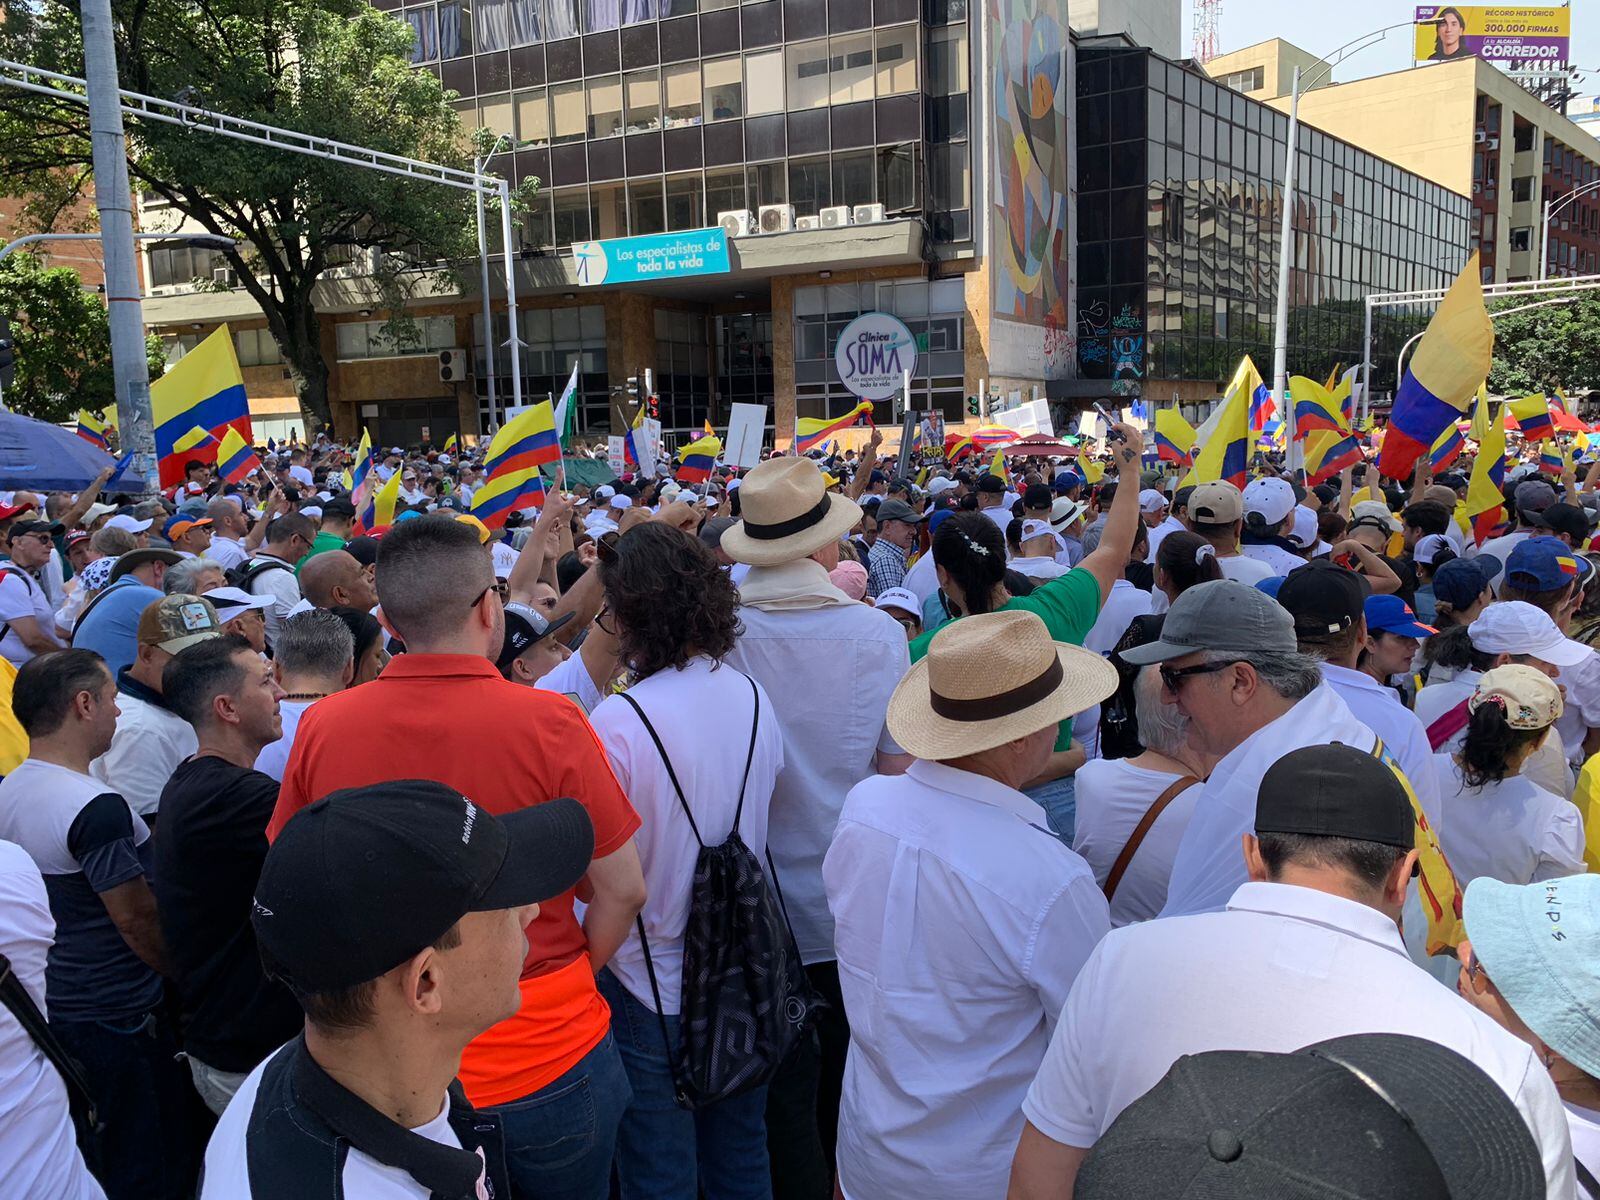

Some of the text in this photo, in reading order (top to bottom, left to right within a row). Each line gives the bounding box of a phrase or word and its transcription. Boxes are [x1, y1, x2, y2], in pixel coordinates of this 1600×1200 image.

[1485, 9, 1555, 17] RÉCORD HISTÓRICO
[1484, 24, 1559, 33] 300.000 FIRMAS
[1481, 45, 1559, 58] CORREDOR
[617, 236, 721, 261] Los especialistas de
[637, 255, 704, 273] toda la vida
[858, 331, 890, 343] Clínica
[845, 341, 903, 379] SOMA
